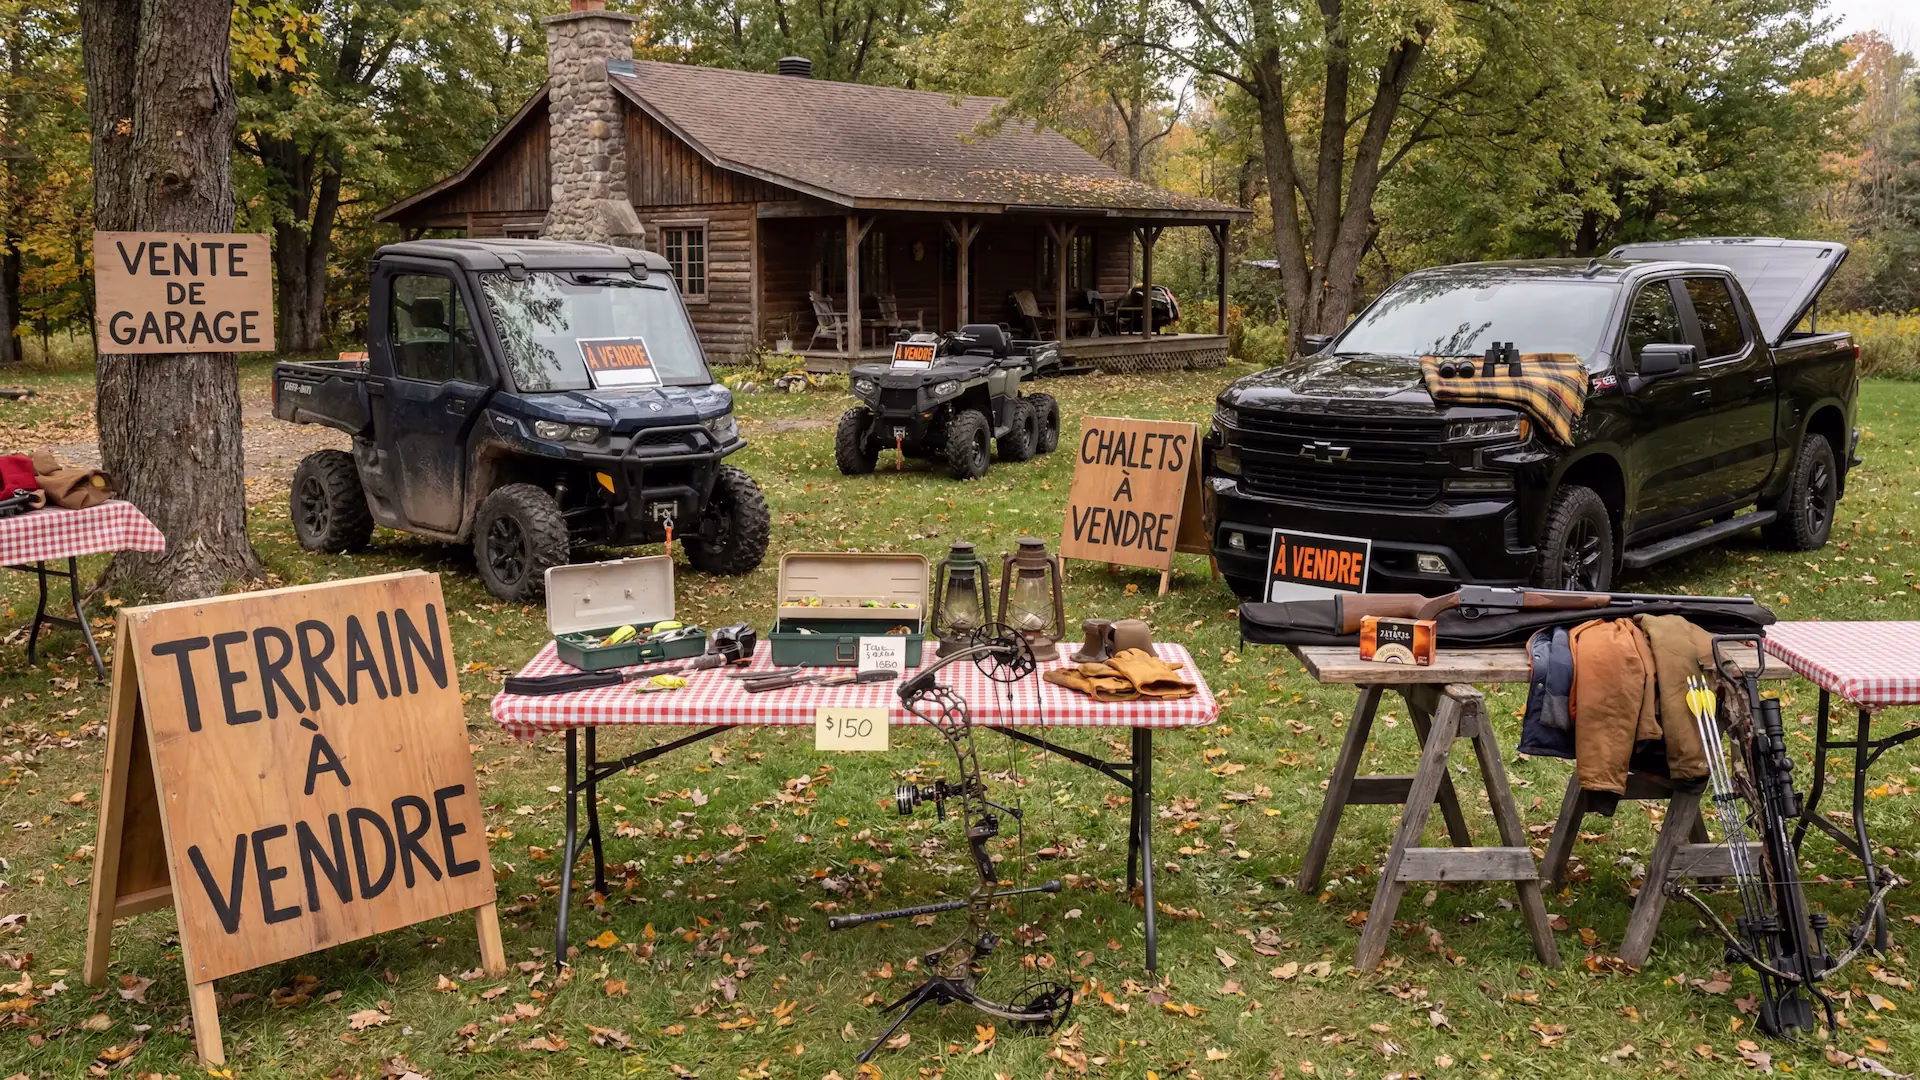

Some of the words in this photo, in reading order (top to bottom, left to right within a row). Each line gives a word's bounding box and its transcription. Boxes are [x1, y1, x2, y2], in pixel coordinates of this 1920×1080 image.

[116, 241, 248, 277] VENTE
[166, 282, 206, 305] DE
[109, 310, 260, 345] GARAGE
[584, 342, 600, 369] À
[596, 344, 649, 368] VENDRE
[903, 346, 934, 361] VENDRE
[1081, 428, 1187, 472] CHALETS
[1113, 469, 1133, 502] À
[1072, 505, 1173, 552] VENDRE
[1273, 535, 1287, 575] À
[1293, 545, 1363, 585] VENDRE
[151, 603, 449, 733] TERRAIN
[825, 715, 873, 738] $150
[299, 717, 351, 796] À
[187, 784, 481, 935] VENDRE
